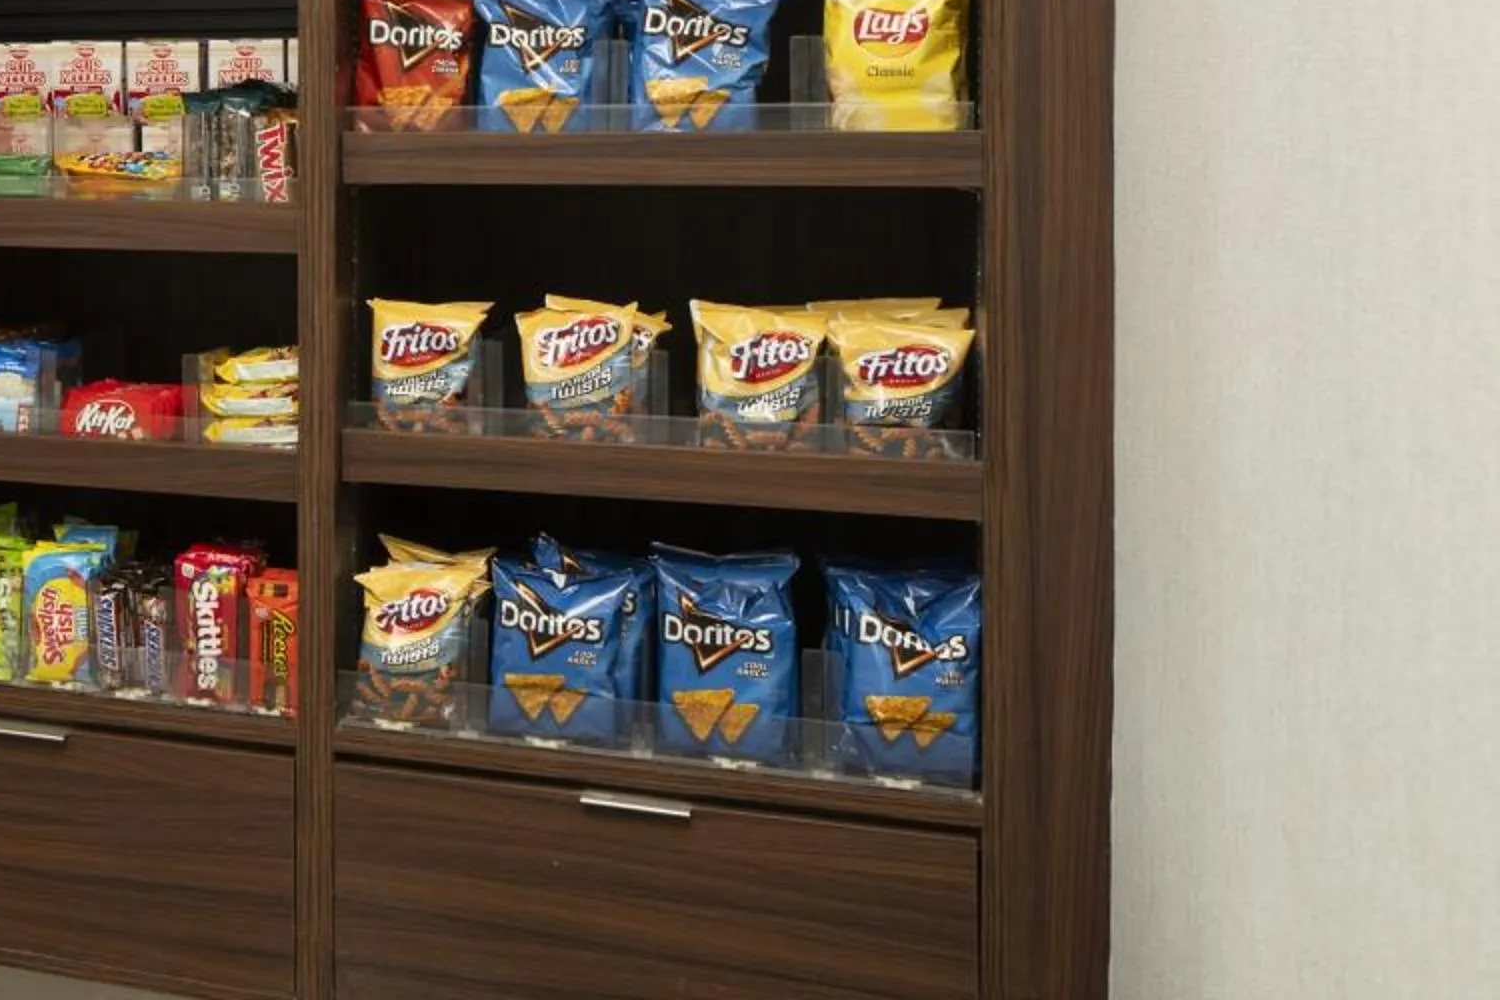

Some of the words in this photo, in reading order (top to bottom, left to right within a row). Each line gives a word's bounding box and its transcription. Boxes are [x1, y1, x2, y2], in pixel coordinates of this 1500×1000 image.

[369, 19, 464, 49] Doritos
[490, 23, 585, 49] Doritos
[645, 8, 748, 47] Doritos
[866, 65, 915, 78] Classic
[382, 323, 458, 360] Fritos
[537, 321, 619, 366] Fritos
[731, 337, 811, 380] Fitos
[857, 348, 950, 384] Fritos
[38, 587, 64, 666] Swedish
[55, 603, 74, 646] Fish
[192, 580, 222, 691] Skittles
[501, 600, 603, 640] Doritos
[664, 614, 771, 650] Doritos
